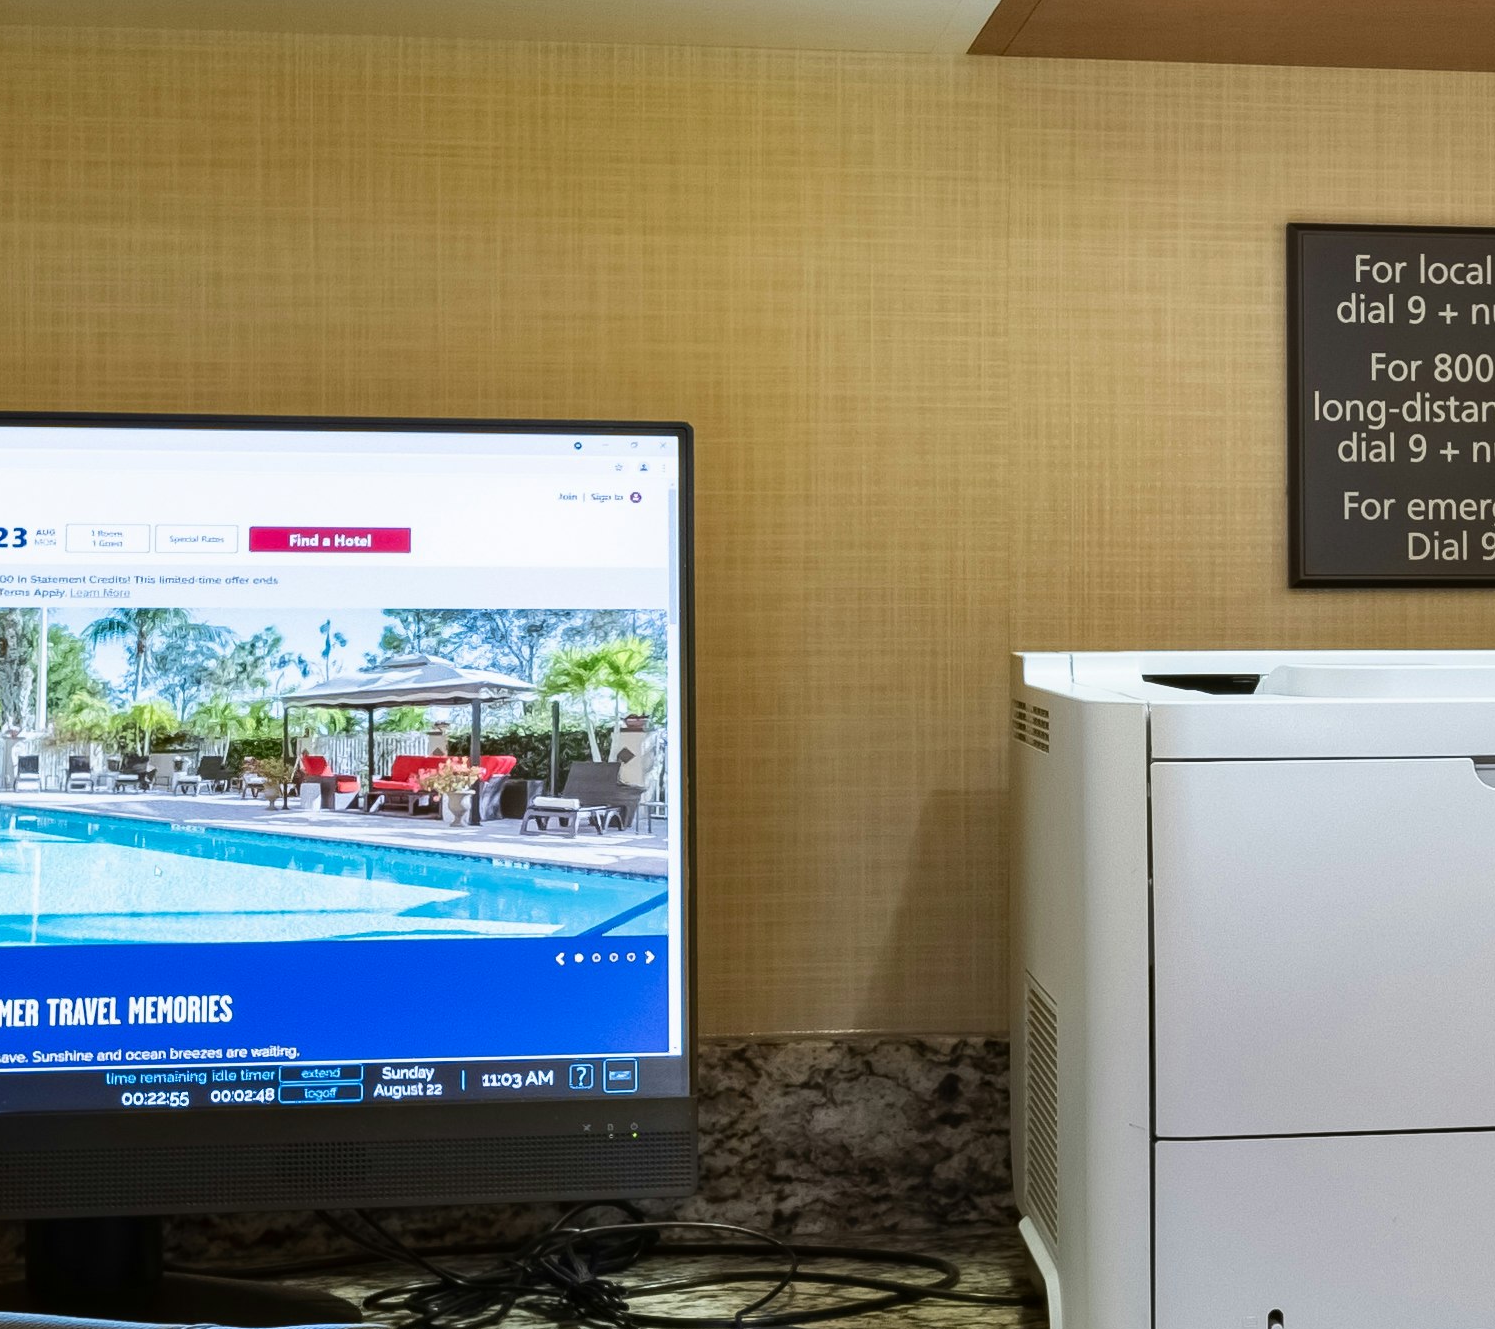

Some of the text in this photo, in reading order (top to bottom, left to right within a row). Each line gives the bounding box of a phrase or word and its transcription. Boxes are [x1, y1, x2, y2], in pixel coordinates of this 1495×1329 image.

[1355, 254, 1407, 283] For
[1419, 253, 1492, 285] local
[1336, 293, 1394, 324] dial
[1407, 295, 1426, 324] 9
[1437, 303, 1458, 325] +
[1370, 352, 1422, 381] For
[1433, 353, 1494, 383] 800
[1337, 431, 1395, 463] dial
[1408, 434, 1427, 463] 9
[1439, 441, 1460, 463] +
[1343, 491, 1396, 520] For
[289, 533, 372, 549] Find a Hotel
[1408, 530, 1468, 561] Dial
[46, 997, 122, 1027] TRAVEL
[128, 995, 234, 1025] MEMORIES
[32, 1048, 94, 1064] Sunshine
[97, 1048, 123, 1062] and
[125, 1049, 167, 1061] ocean
[170, 1045, 222, 1060] breezes
[225, 1047, 248, 1059] are
[140, 1070, 207, 1084] remaining
[240, 1069, 275, 1082] timer
[301, 1067, 341, 1079] extend
[381, 1065, 436, 1082] Sunday
[481, 1070, 554, 1089] 11:03 AM
[120, 1090, 190, 1107] 00:22:55
[210, 1087, 275, 1104] 00:02:48
[304, 1087, 338, 1101] logoff
[373, 1083, 443, 1099] August 22
